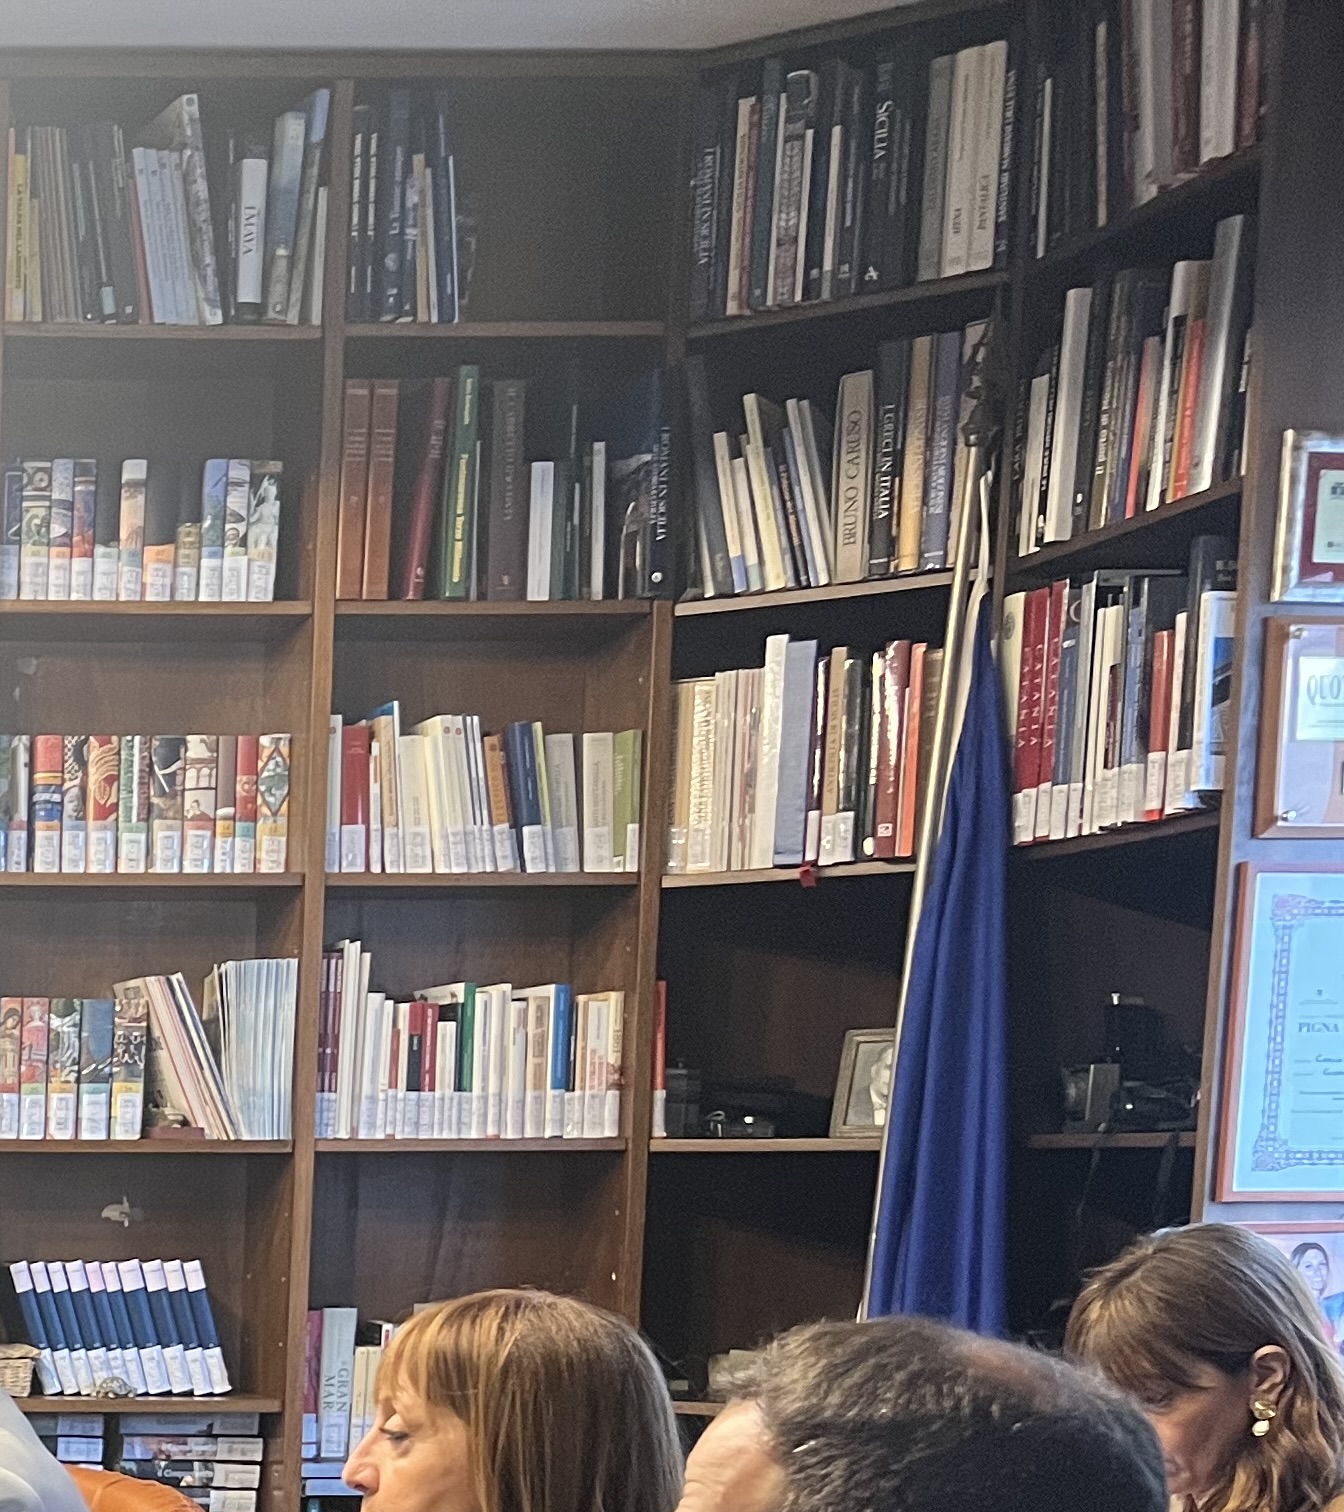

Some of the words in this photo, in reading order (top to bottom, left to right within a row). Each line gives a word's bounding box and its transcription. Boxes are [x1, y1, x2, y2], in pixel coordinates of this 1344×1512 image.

[844, 409, 862, 480] CARUSO
[842, 486, 859, 547] BRUNO
[877, 476, 892, 519] ITALIA
[1306, 674, 1344, 705] QUO
